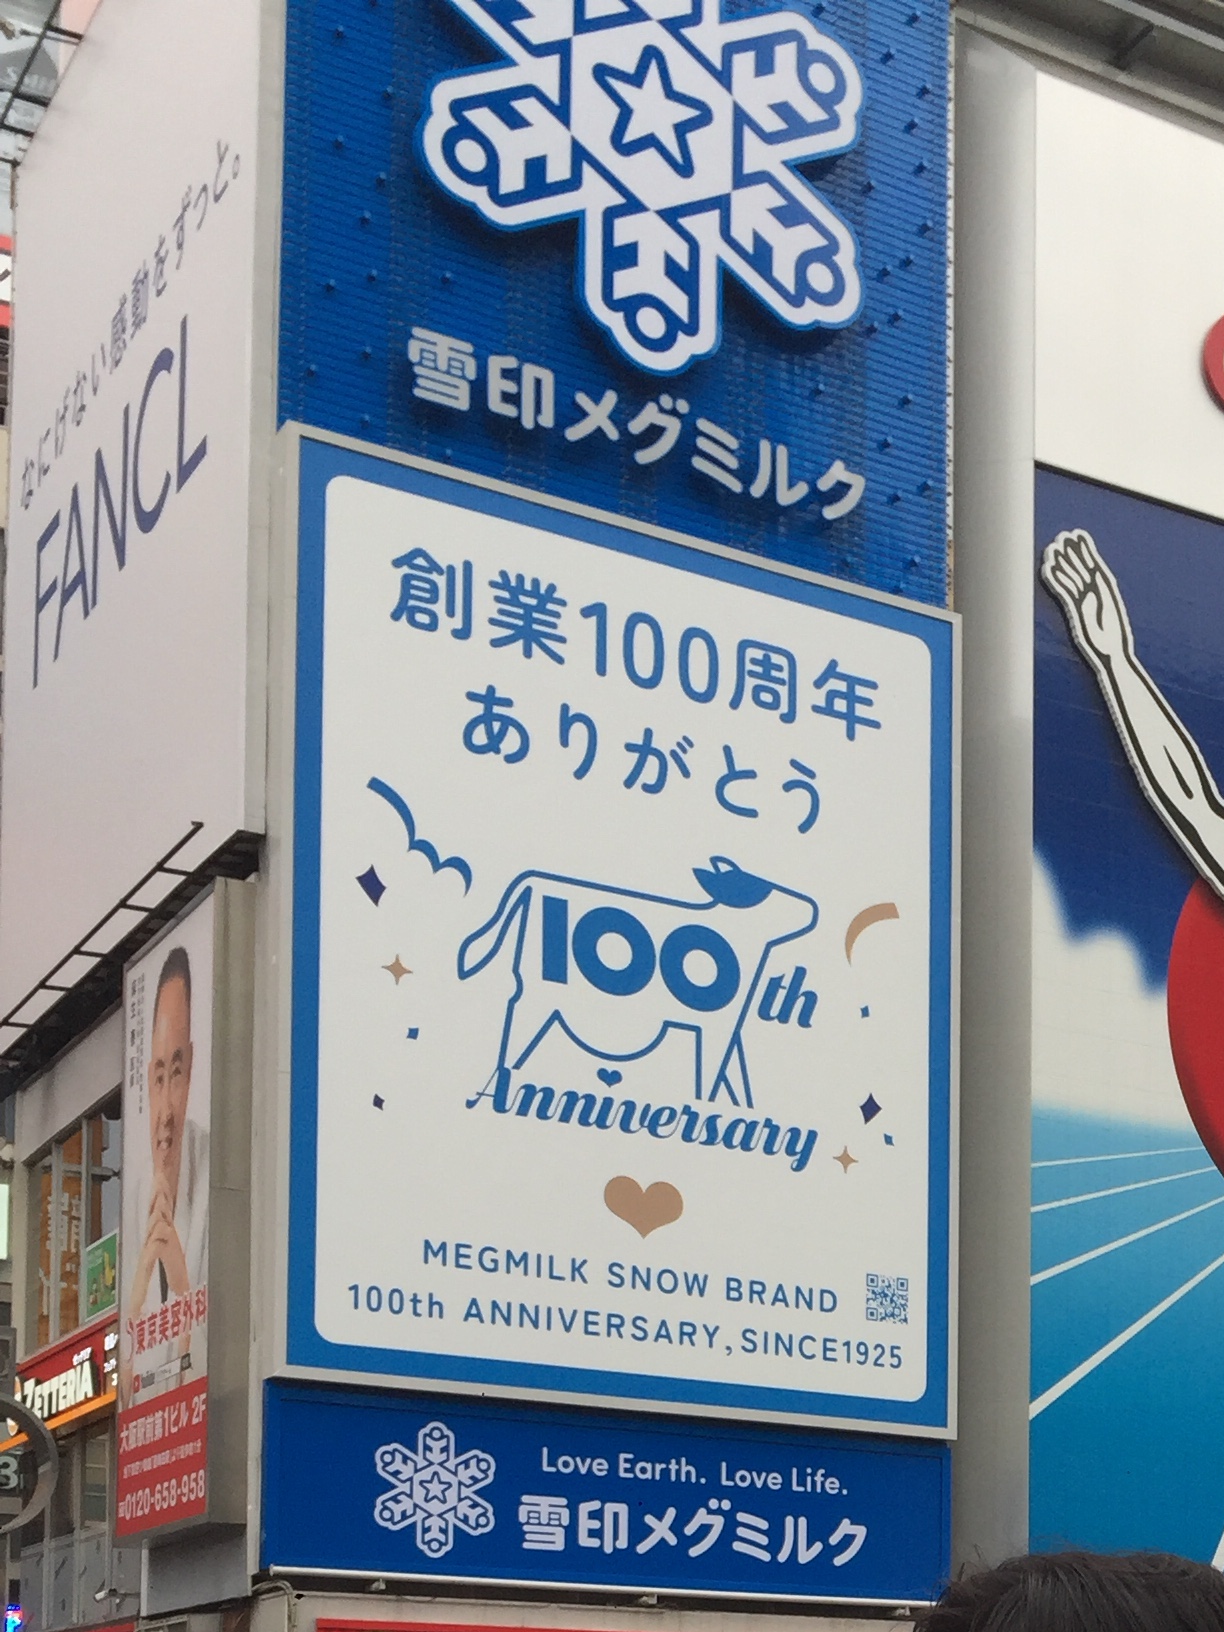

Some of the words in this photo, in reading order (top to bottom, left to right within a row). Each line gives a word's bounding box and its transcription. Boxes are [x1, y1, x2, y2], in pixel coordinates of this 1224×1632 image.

[407, 326, 866, 520] 雪印メグミルク
[32, 313, 208, 690] FANCL
[390, 547, 882, 741] 創業100周年
[461, 685, 822, 834] ありがとう
[542, 895, 741, 1012] 100
[756, 966, 819, 1029] th
[465, 1065, 819, 1173] Anniversary
[347, 1284, 444, 1320] 100th
[422, 1238, 589, 1285] MEGMILK
[607, 1262, 708, 1300] SNOW
[725, 1276, 837, 1314] BRAND
[518, 1495, 867, 1567] 雪印メグミルク
[541, 1447, 608, 1477] Love
[619, 1454, 706, 1486] Earth.
[720, 1462, 782, 1490] Love
[791, 1468, 849, 1496] Life.
